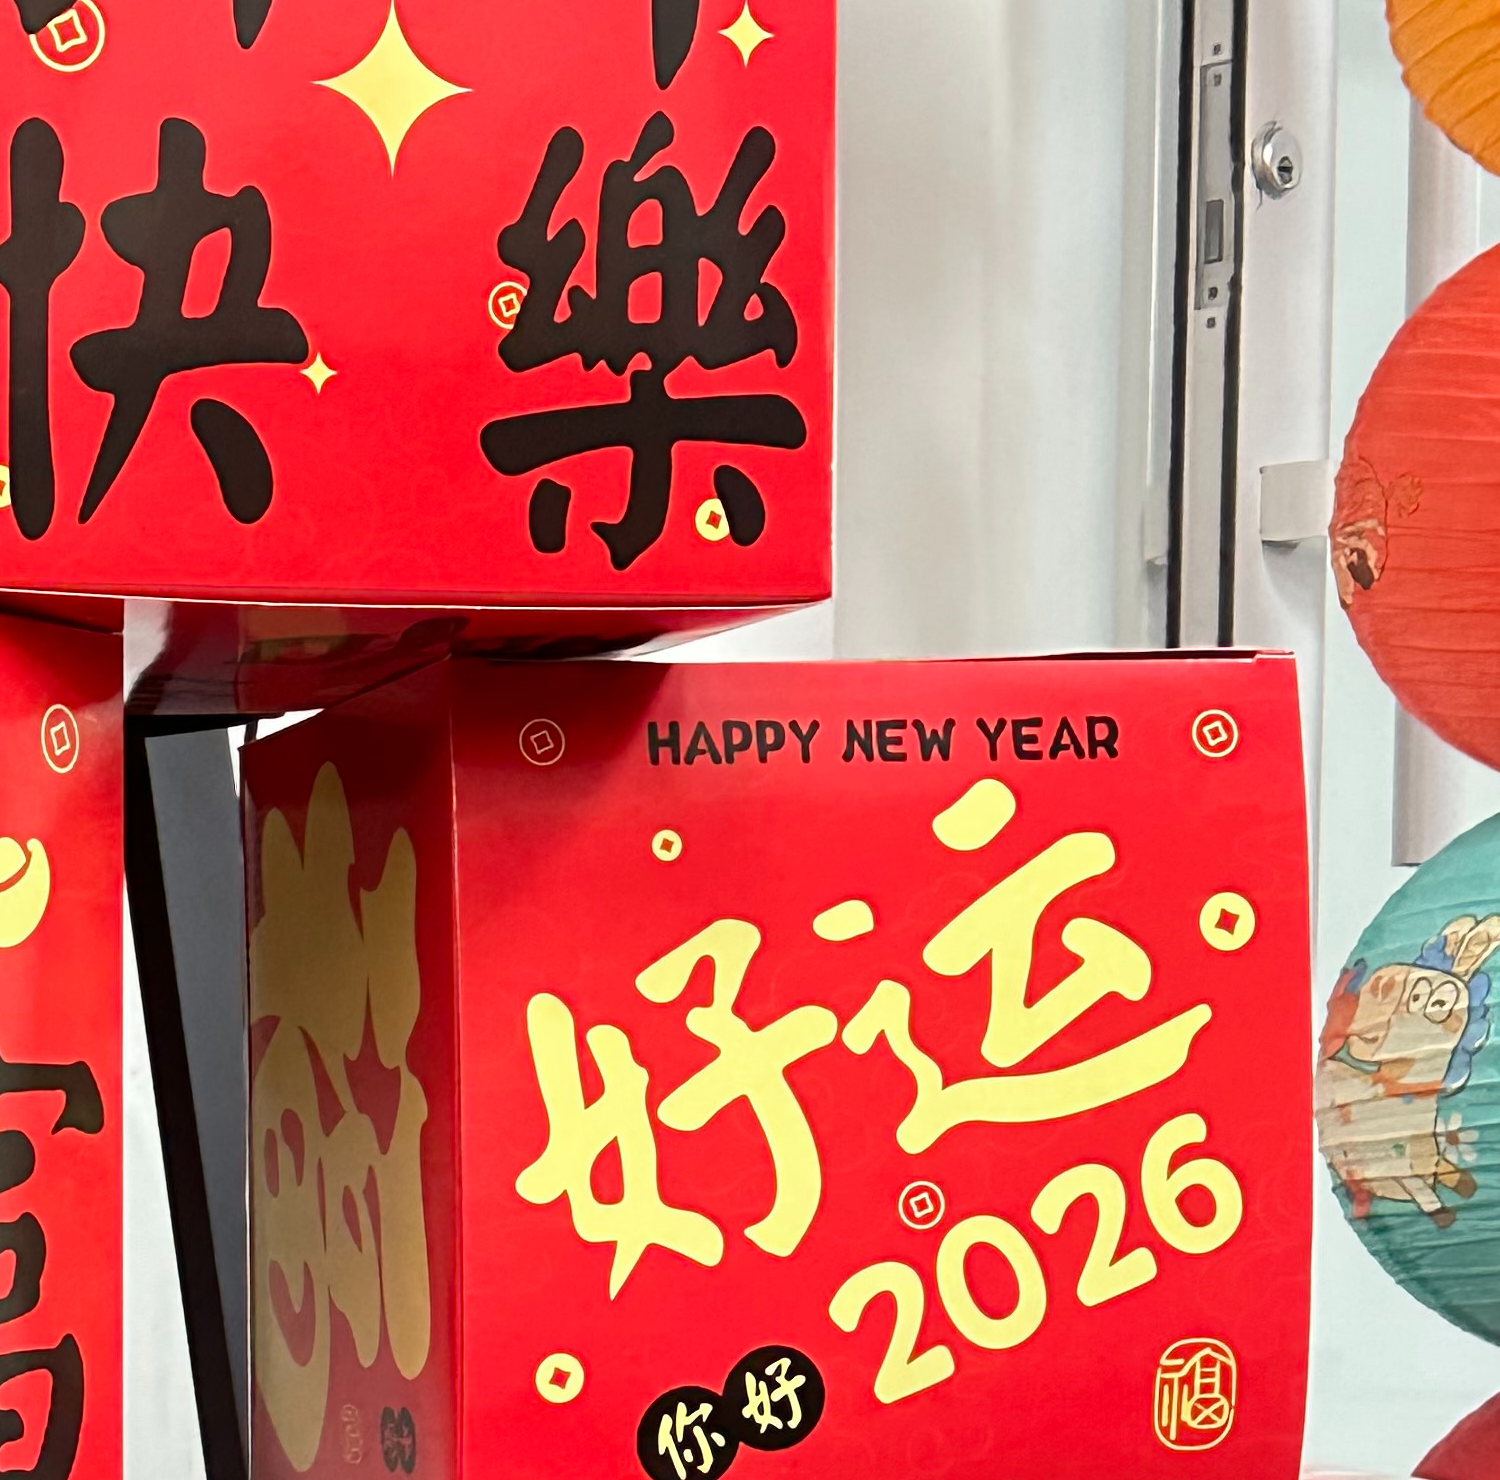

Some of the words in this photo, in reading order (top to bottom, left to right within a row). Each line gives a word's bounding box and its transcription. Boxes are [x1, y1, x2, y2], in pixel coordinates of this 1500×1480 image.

[647, 719, 820, 766] HAPPY
[842, 719, 956, 763] NEW
[975, 716, 1119, 762] YEAR
[515, 779, 1213, 1301] 好运
[827, 1112, 1243, 1404] 2026
[657, 1356, 808, 1480] 你好
